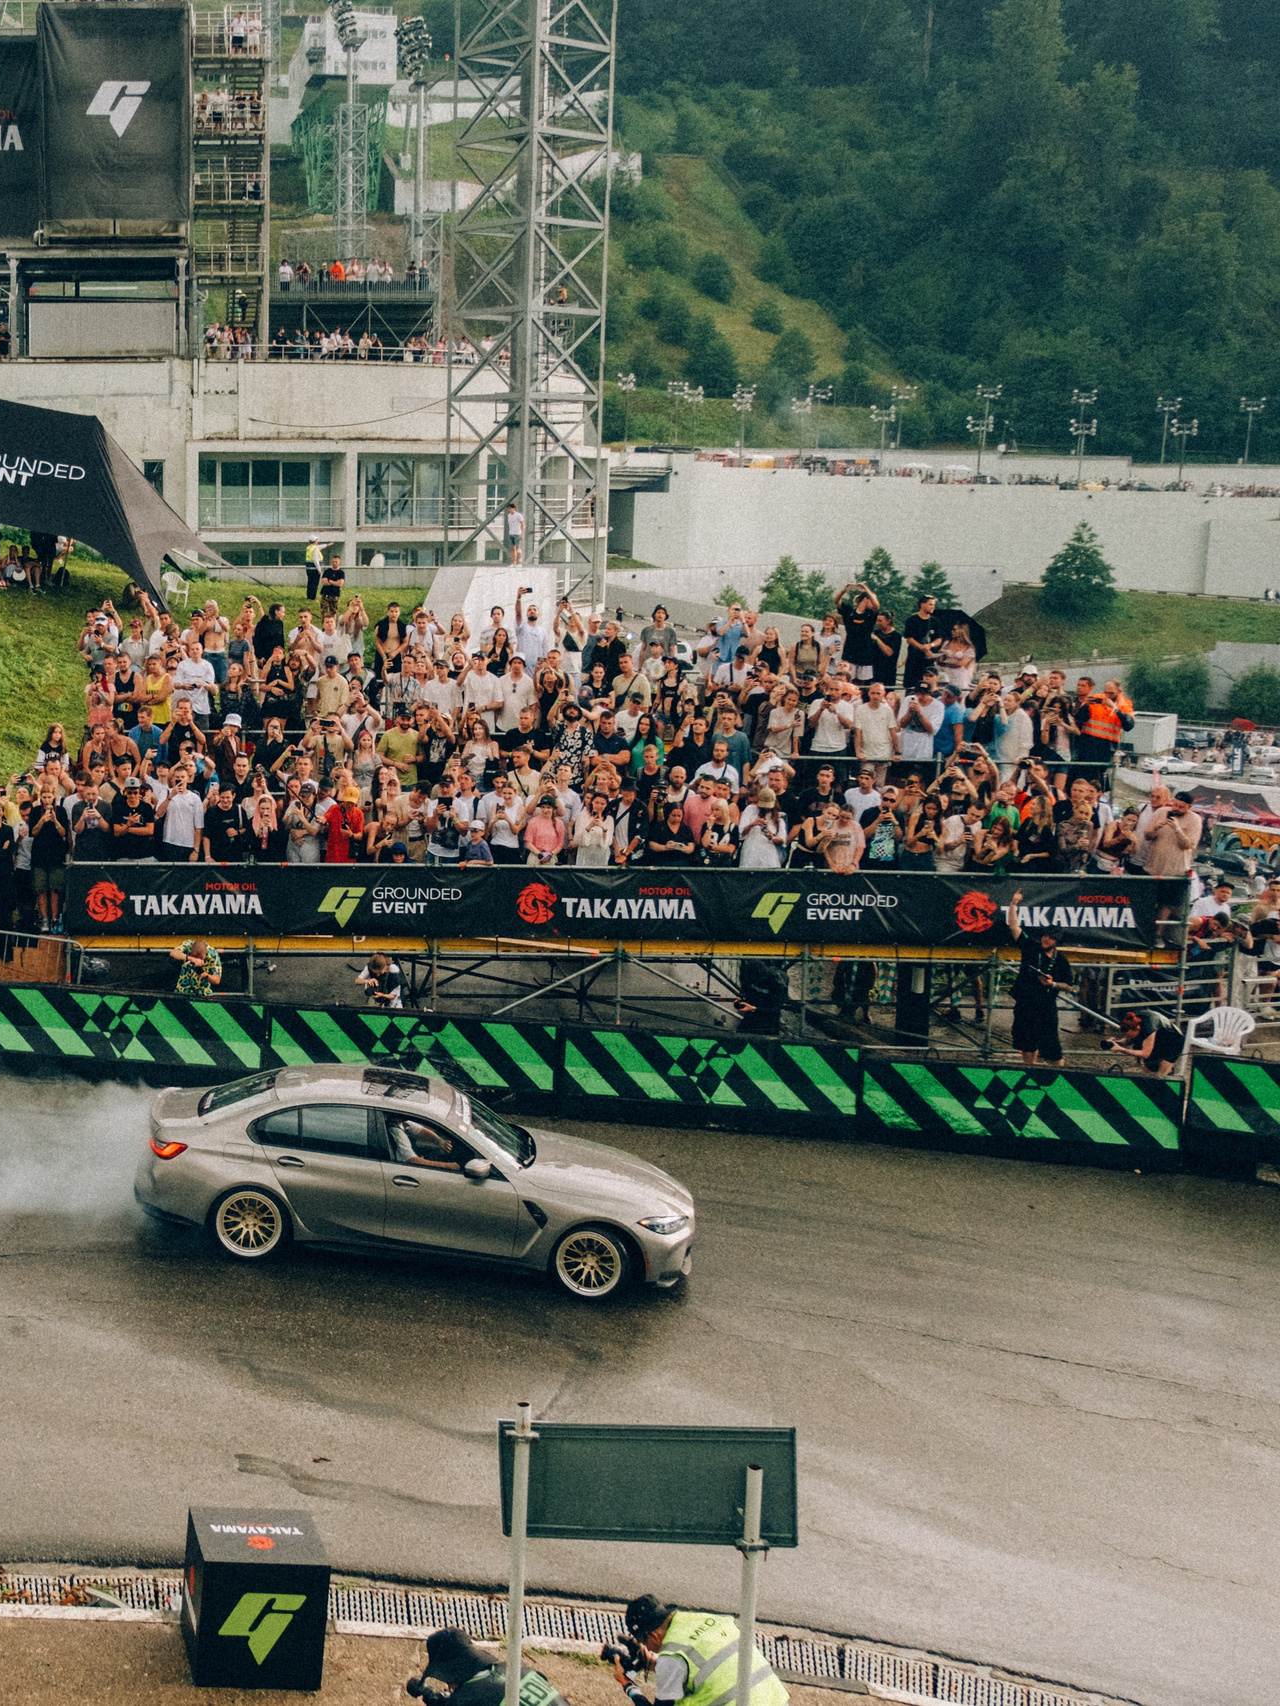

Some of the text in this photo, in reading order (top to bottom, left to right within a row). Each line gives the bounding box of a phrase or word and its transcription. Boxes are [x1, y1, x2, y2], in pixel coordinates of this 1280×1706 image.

[205, 882, 258, 892] MOTOR OIL
[372, 886, 462, 901] GROUNDED
[638, 886, 692, 896] MOTOR OIL
[129, 894, 263, 915] TAKAYAMA
[806, 893, 898, 908] GROUNDED
[1078, 895, 1131, 905] MOTOR OIL
[372, 901, 427, 914] EVENT
[561, 897, 696, 920] TAKAYAMA
[806, 908, 863, 921] EVENT
[1001, 905, 1136, 928] TAKAYAMA
[210, 1524, 304, 1535] TAKAYAMA
